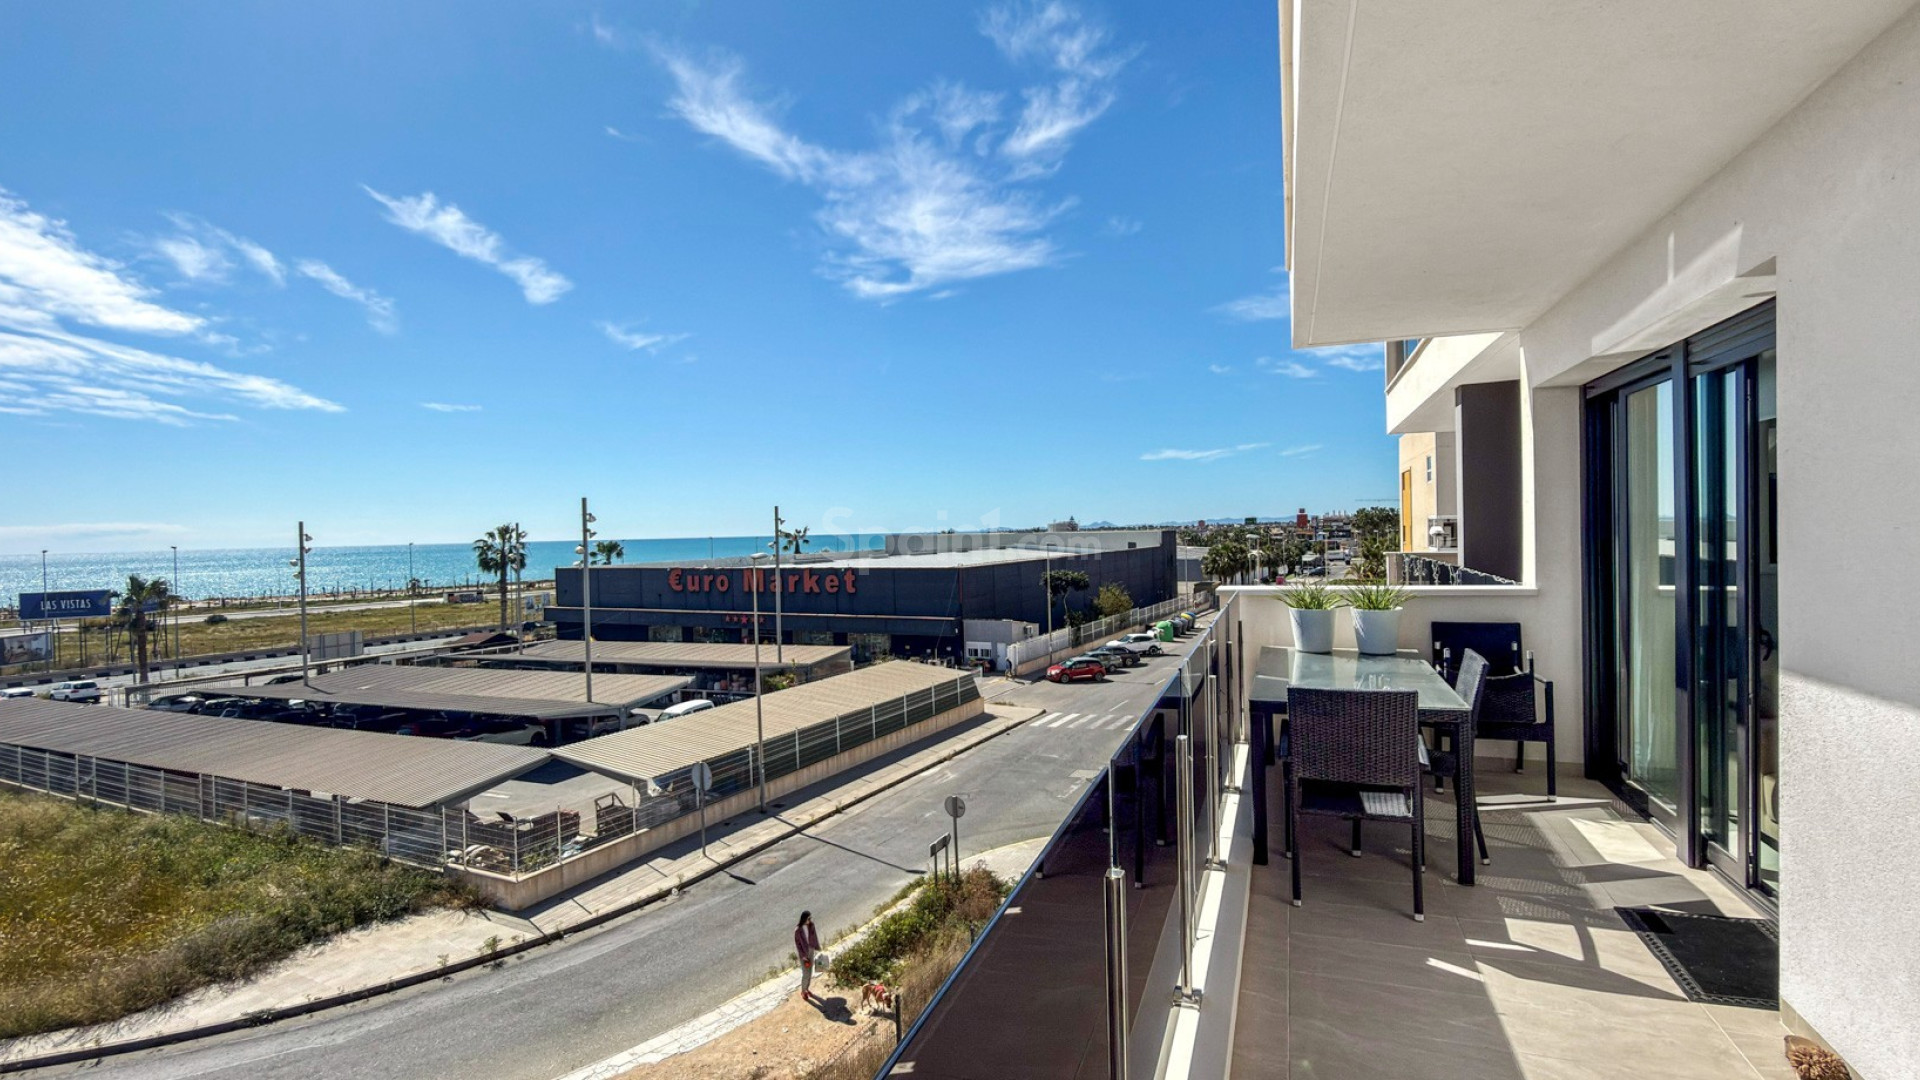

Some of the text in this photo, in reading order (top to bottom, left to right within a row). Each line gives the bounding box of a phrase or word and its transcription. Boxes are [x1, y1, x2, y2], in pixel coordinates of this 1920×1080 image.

[743, 568, 856, 593] Market
[41, 599, 91, 610] LAS VISTAS
